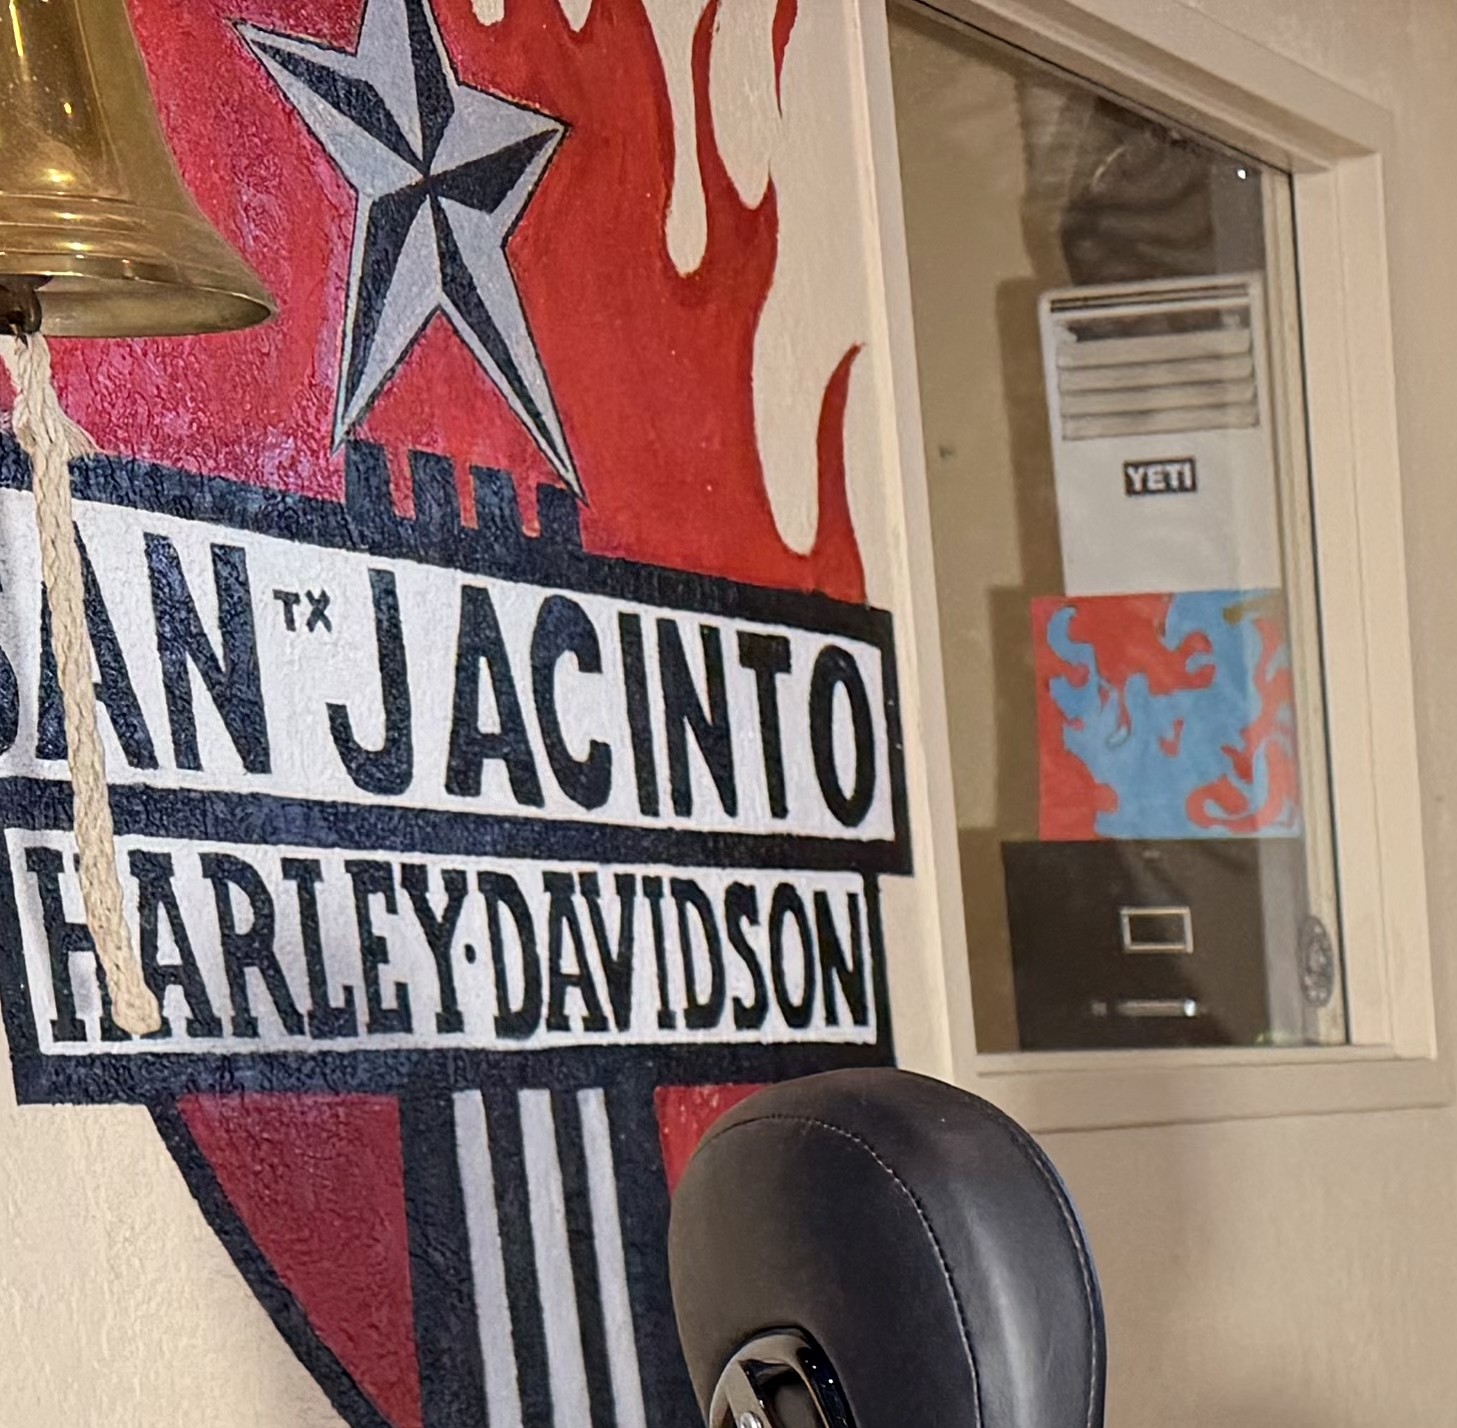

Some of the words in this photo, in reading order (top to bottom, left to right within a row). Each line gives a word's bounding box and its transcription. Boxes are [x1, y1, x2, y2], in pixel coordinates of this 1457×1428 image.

[1127, 464, 1192, 492] YETI
[273, 588, 332, 633] TX
[326, 568, 873, 827] JACINTO
